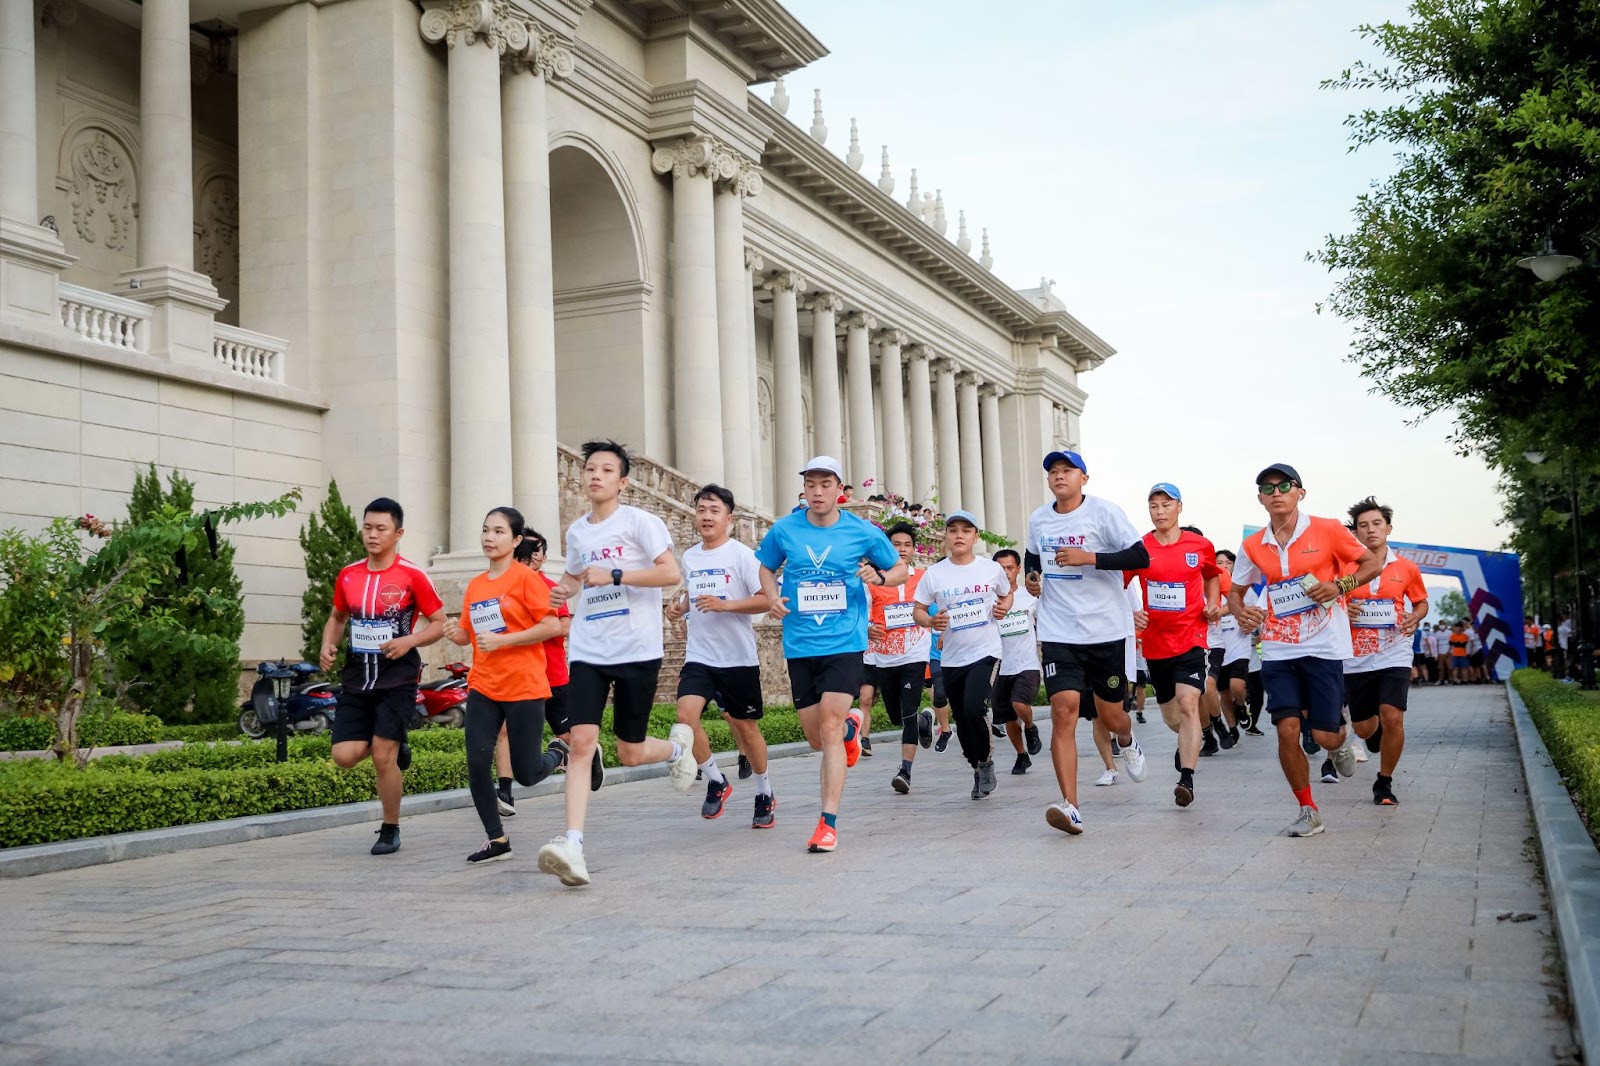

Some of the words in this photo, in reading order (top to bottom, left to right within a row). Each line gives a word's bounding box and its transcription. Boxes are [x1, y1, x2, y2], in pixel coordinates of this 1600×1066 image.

[1040, 535, 1085, 546] H.E.A.R.T
[587, 591, 621, 605] 10006VP
[804, 593, 841, 602] 10039VF
[942, 584, 990, 598] H.E.A.R.T
[1045, 662, 1057, 678] 10
